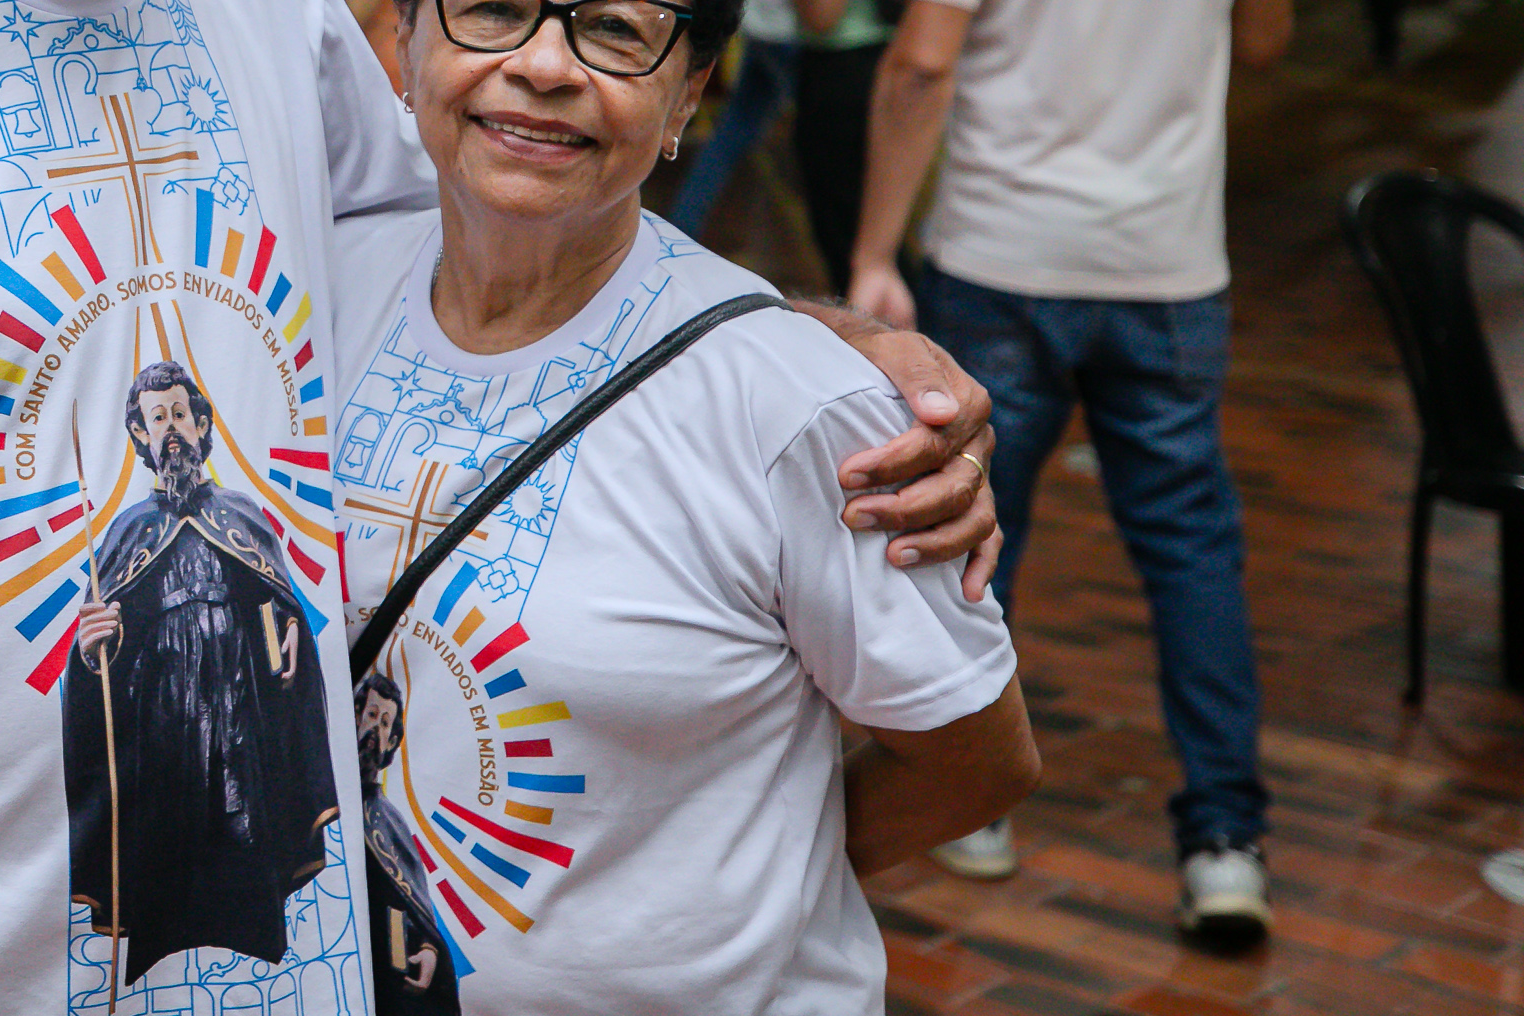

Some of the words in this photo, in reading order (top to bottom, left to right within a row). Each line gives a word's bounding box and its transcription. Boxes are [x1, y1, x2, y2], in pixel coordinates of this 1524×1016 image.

[116, 271, 177, 302] SOMOS
[183, 271, 264, 330] ENVIADOS
[261, 327, 282, 359] EM
[19, 353, 62, 426] SANTO
[16, 432, 36, 481] COM
[412, 620, 478, 701] ENVIADOS
[469, 704, 490, 732] EM
[477, 737, 500, 807] MISSÃO
